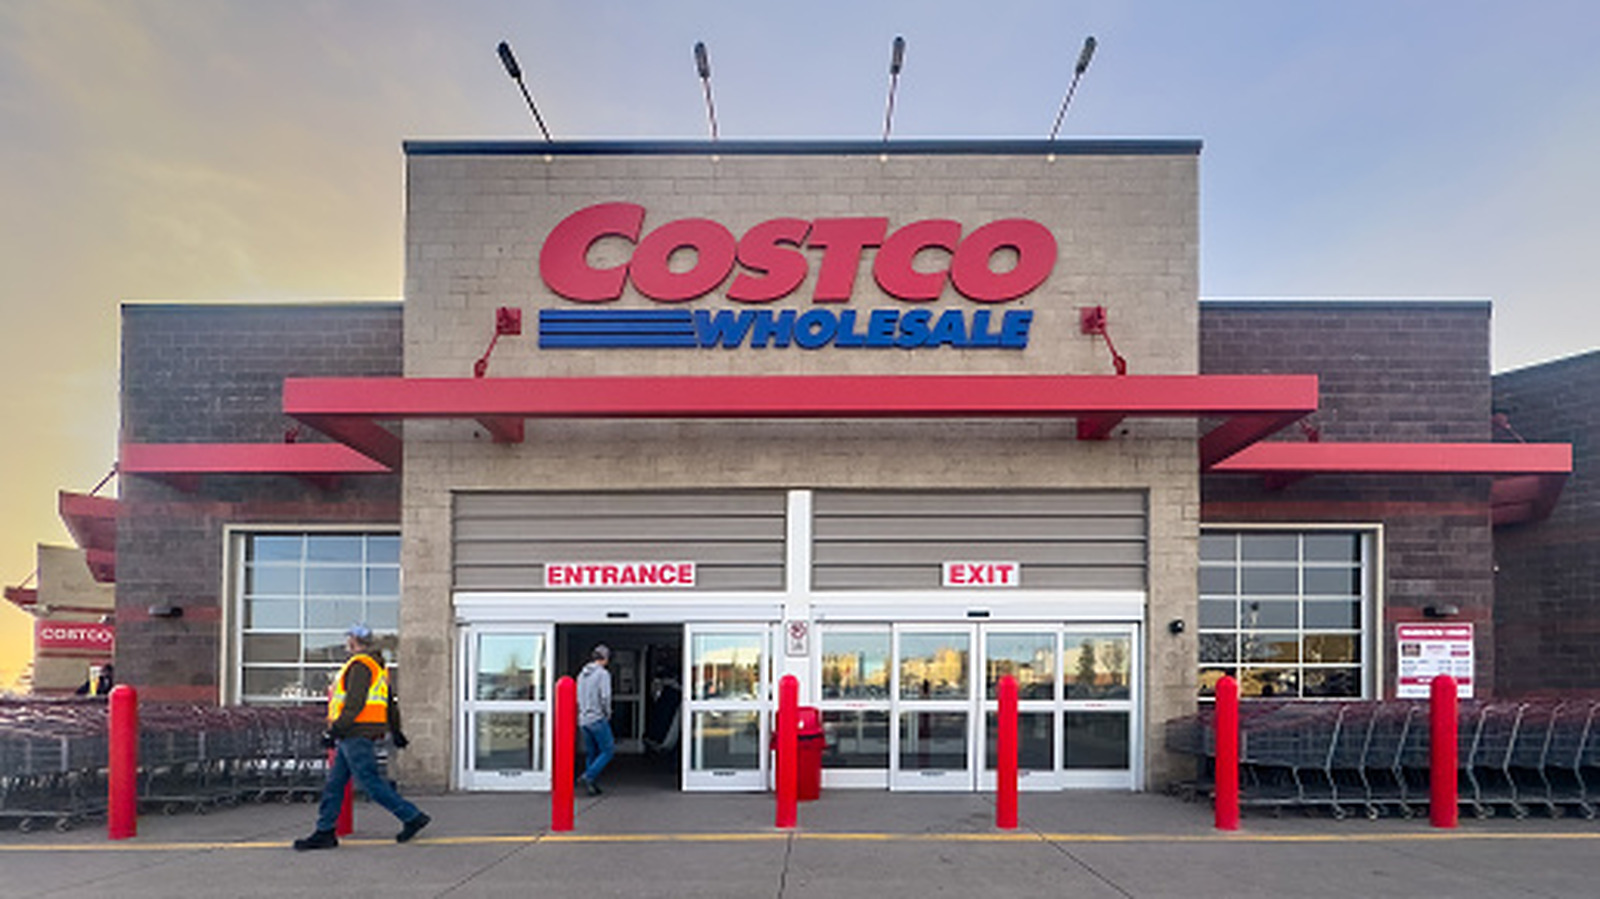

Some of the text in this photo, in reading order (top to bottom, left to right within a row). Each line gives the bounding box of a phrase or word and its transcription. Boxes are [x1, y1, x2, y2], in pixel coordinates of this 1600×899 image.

[539, 202, 1058, 303] COSTCO
[693, 309, 1033, 350] WHOLESALE
[548, 564, 692, 585] ENTRANCE
[949, 564, 1014, 584] EXIT
[42, 628, 113, 642] COSTCO
